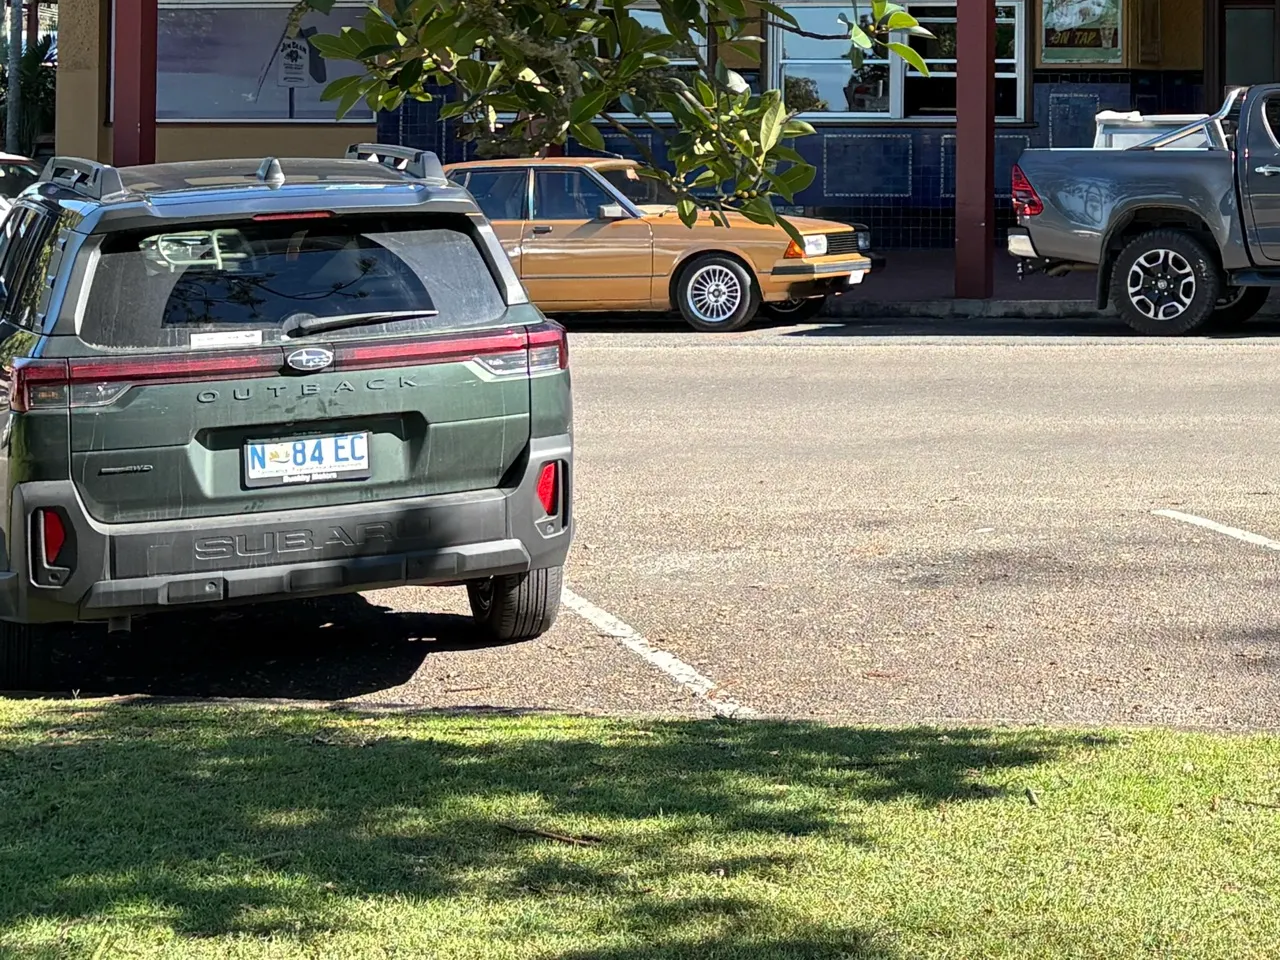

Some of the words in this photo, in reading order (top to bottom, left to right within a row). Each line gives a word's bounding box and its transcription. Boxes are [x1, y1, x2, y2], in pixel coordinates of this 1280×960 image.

[1050, 31, 1069, 44] ON
[1074, 31, 1097, 44] TAP
[196, 374, 418, 404] OUTBACK
[249, 444, 266, 470] N
[292, 439, 324, 466] 84
[334, 435, 365, 463] EC
[194, 515, 432, 562] SUBARU
